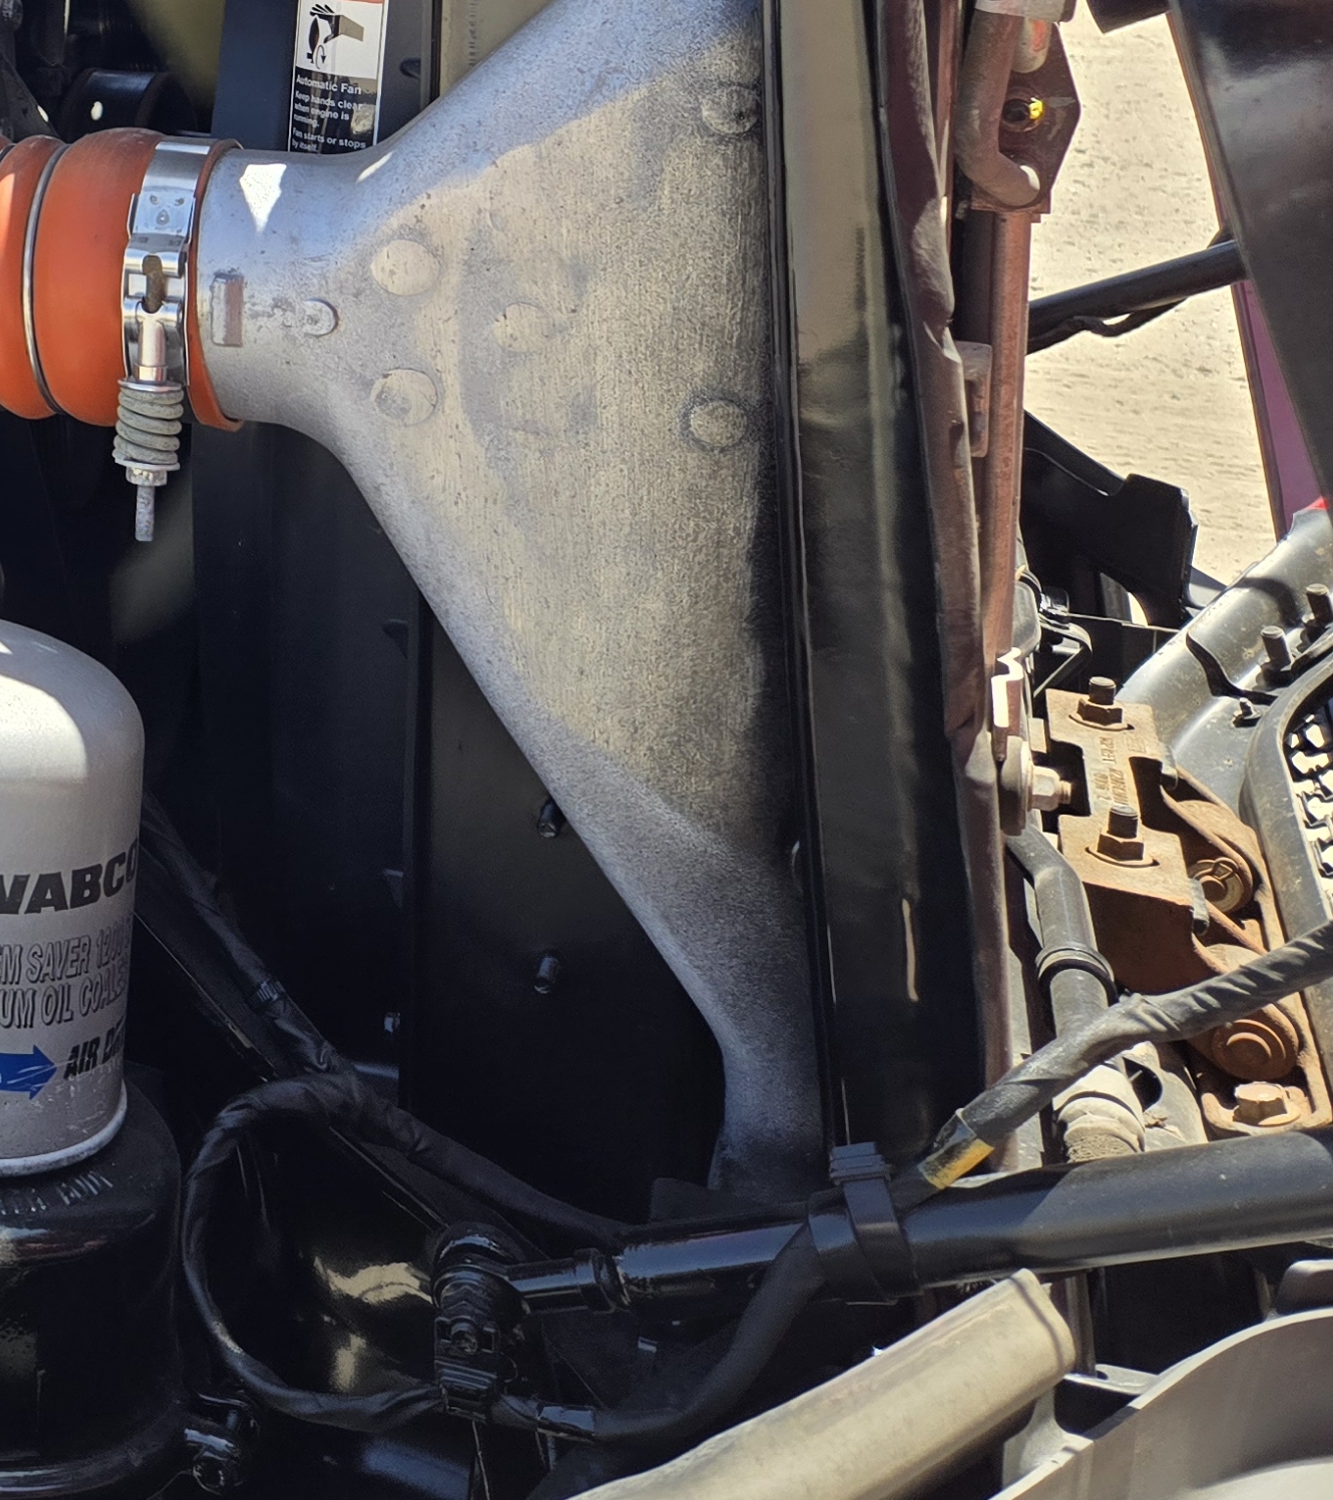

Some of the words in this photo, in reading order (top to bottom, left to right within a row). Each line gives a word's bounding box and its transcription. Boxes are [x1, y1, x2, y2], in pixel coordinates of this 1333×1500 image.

[296, 75, 338, 91] Automatic
[340, 83, 362, 95] Fan
[295, 90, 309, 102] Keep
[311, 94, 335, 107] hands
[338, 97, 363, 110] clear
[294, 103, 309, 113] when
[311, 107, 338, 120] engine
[340, 111, 350, 120] is
[294, 114, 319, 128] running.
[293, 127, 303, 138] Fan
[304, 129, 325, 142] starts
[327, 135, 337, 144] or
[338, 137, 366, 150] stops
[26, 934, 92, 984] SAVER
[40, 981, 74, 1026] OIL
[63, 1036, 100, 1080] AIR
